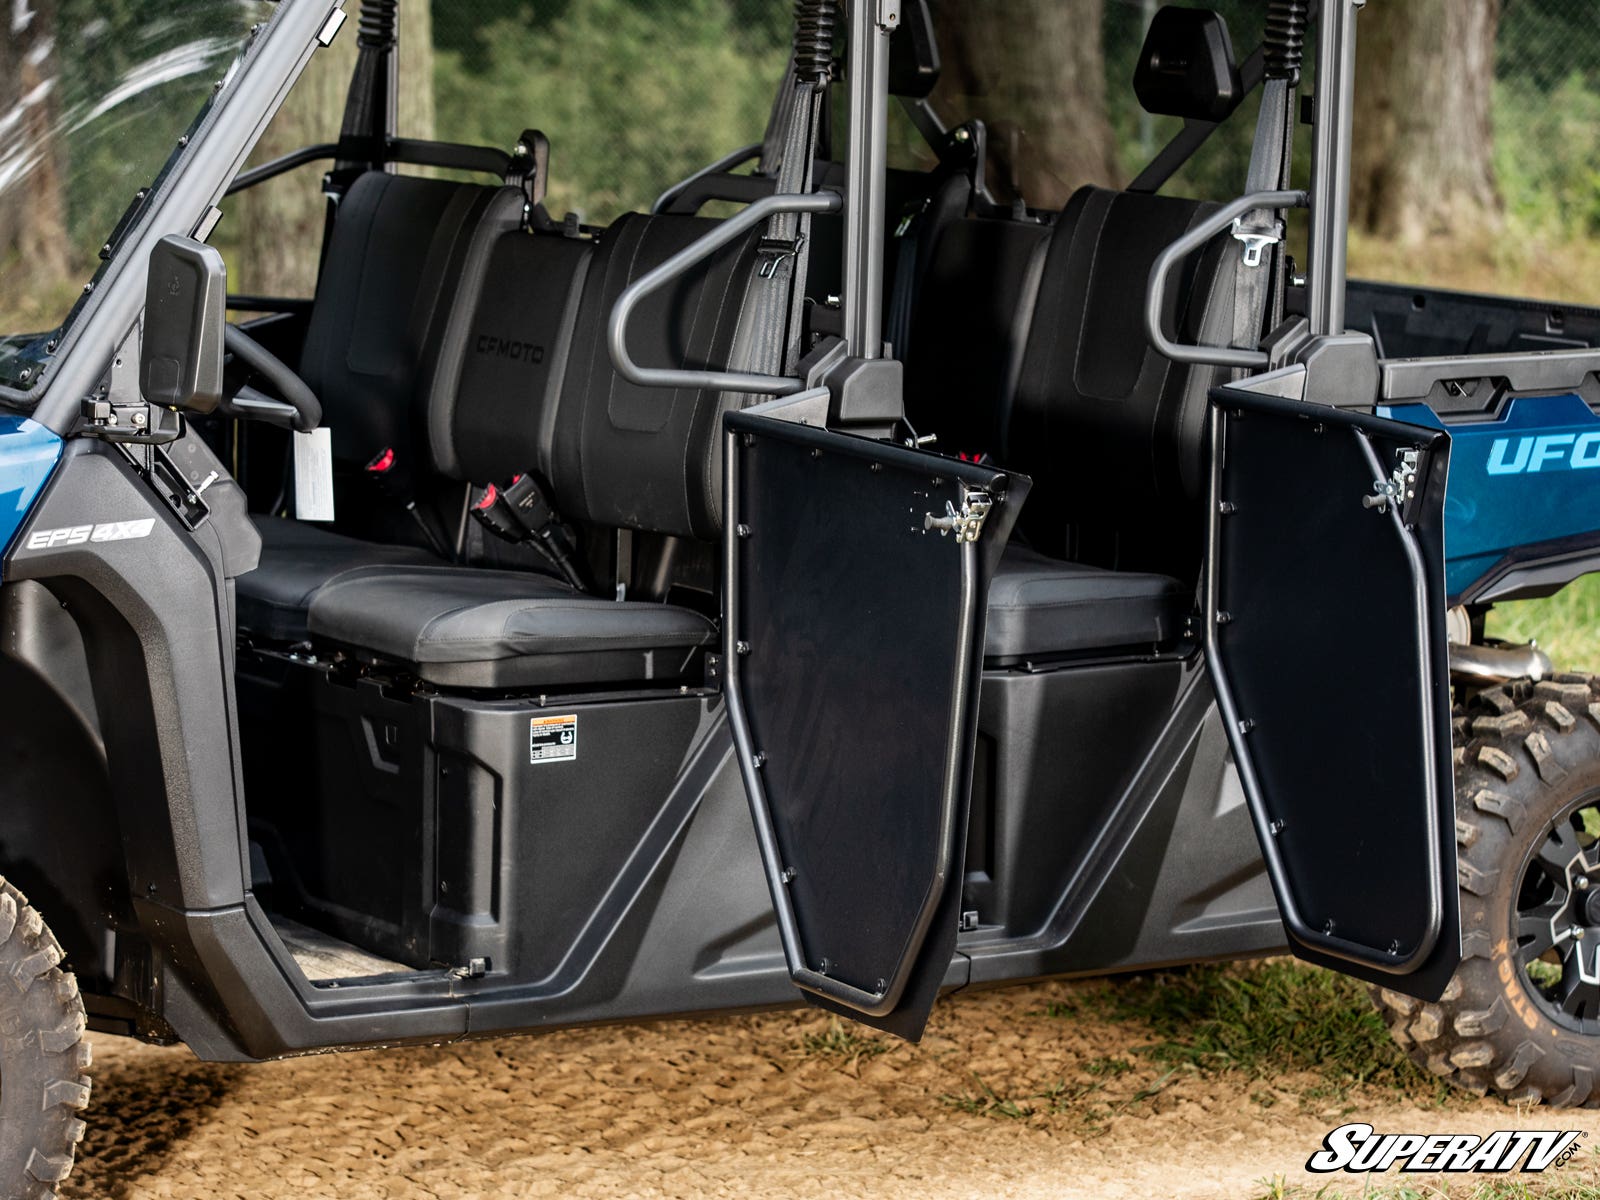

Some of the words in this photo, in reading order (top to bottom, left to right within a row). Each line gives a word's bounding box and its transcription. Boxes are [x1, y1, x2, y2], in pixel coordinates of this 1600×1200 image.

[476, 335, 545, 364] CFMOTO
[26, 525, 93, 550] EPS
[1498, 958, 1539, 1030] STAG
